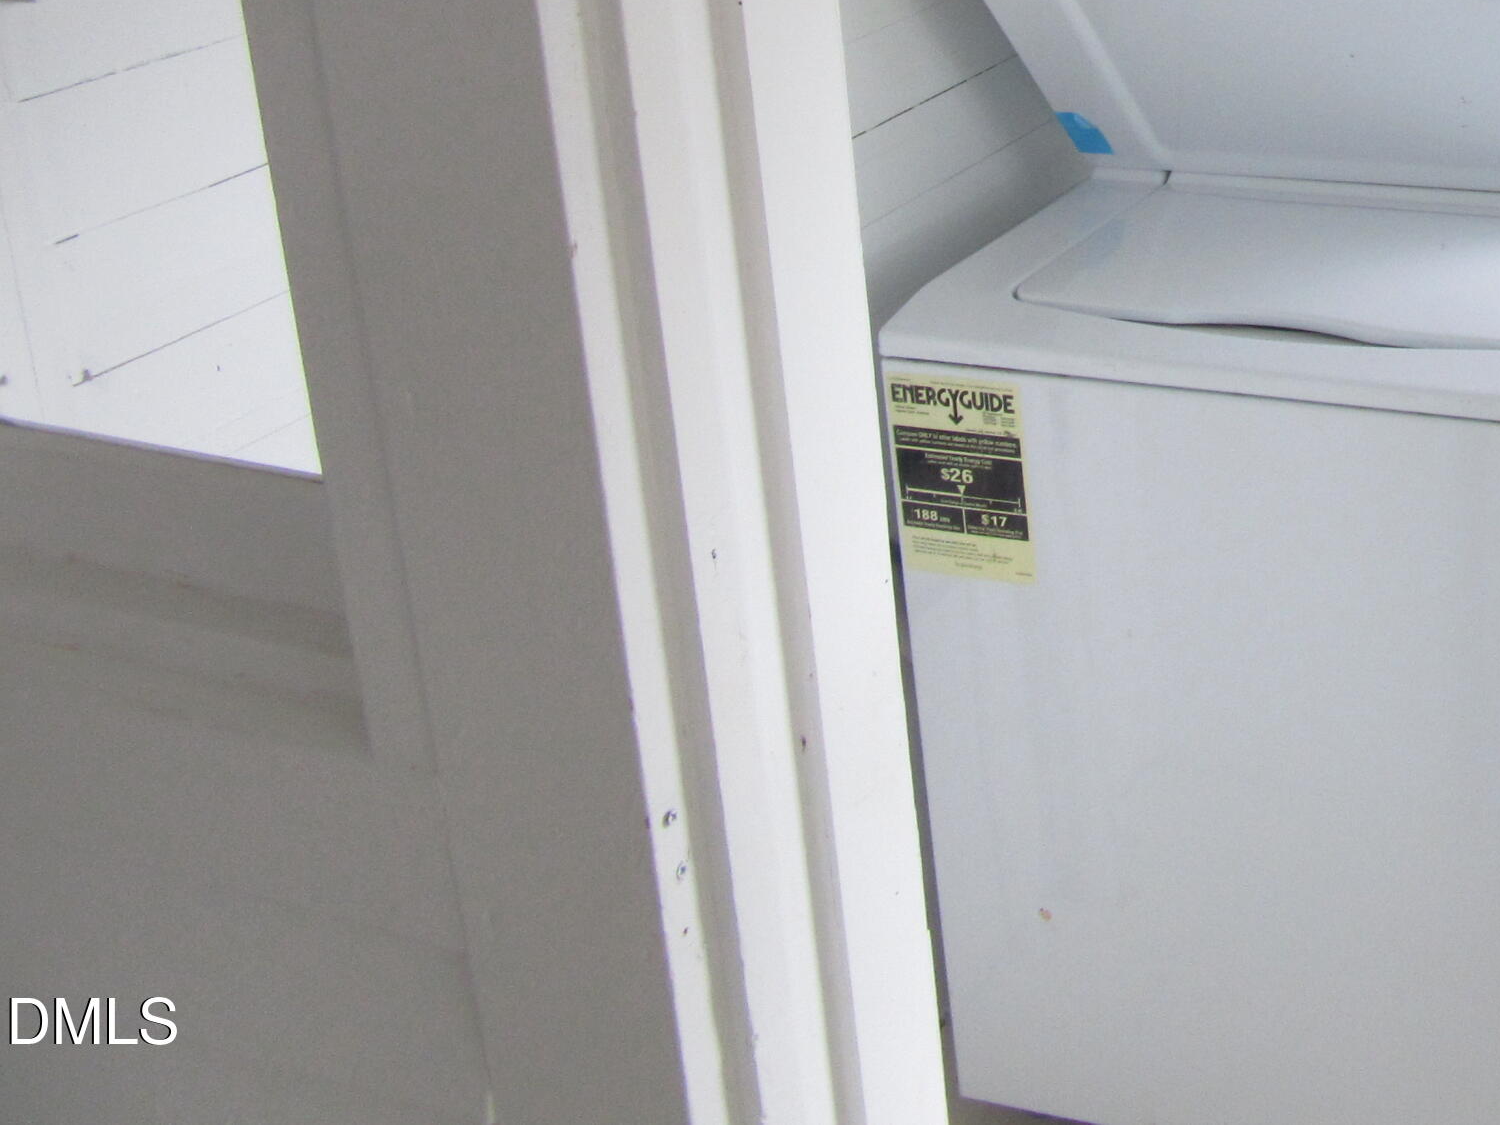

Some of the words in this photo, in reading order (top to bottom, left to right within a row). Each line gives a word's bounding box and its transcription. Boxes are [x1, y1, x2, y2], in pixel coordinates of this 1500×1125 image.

[890, 383, 1016, 418] ENERGYGUIDE
[940, 467, 974, 484] $26
[913, 508, 938, 521] 188
